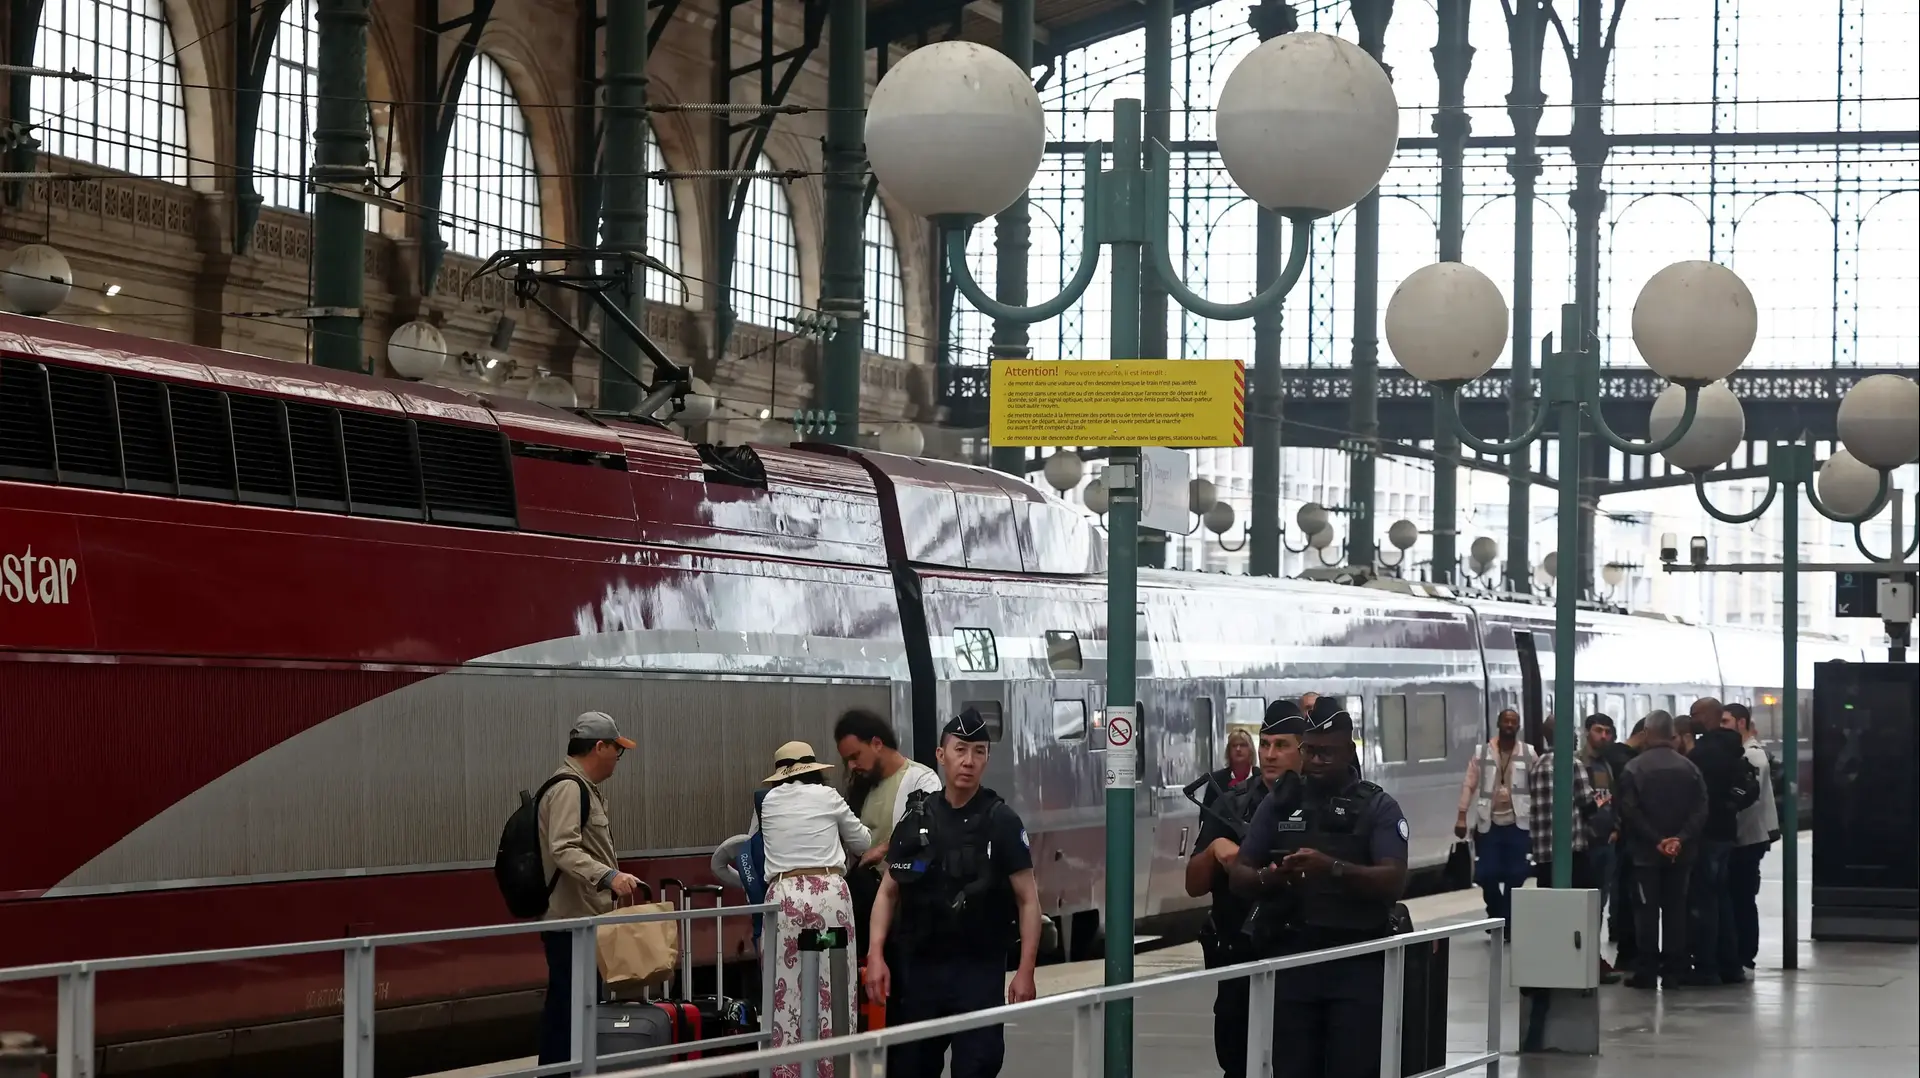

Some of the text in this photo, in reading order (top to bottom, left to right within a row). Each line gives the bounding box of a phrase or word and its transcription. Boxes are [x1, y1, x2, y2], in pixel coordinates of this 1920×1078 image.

[1005, 366, 1059, 376] Attention!
[0, 544, 77, 604] star
[1844, 574, 1853, 586] 9
